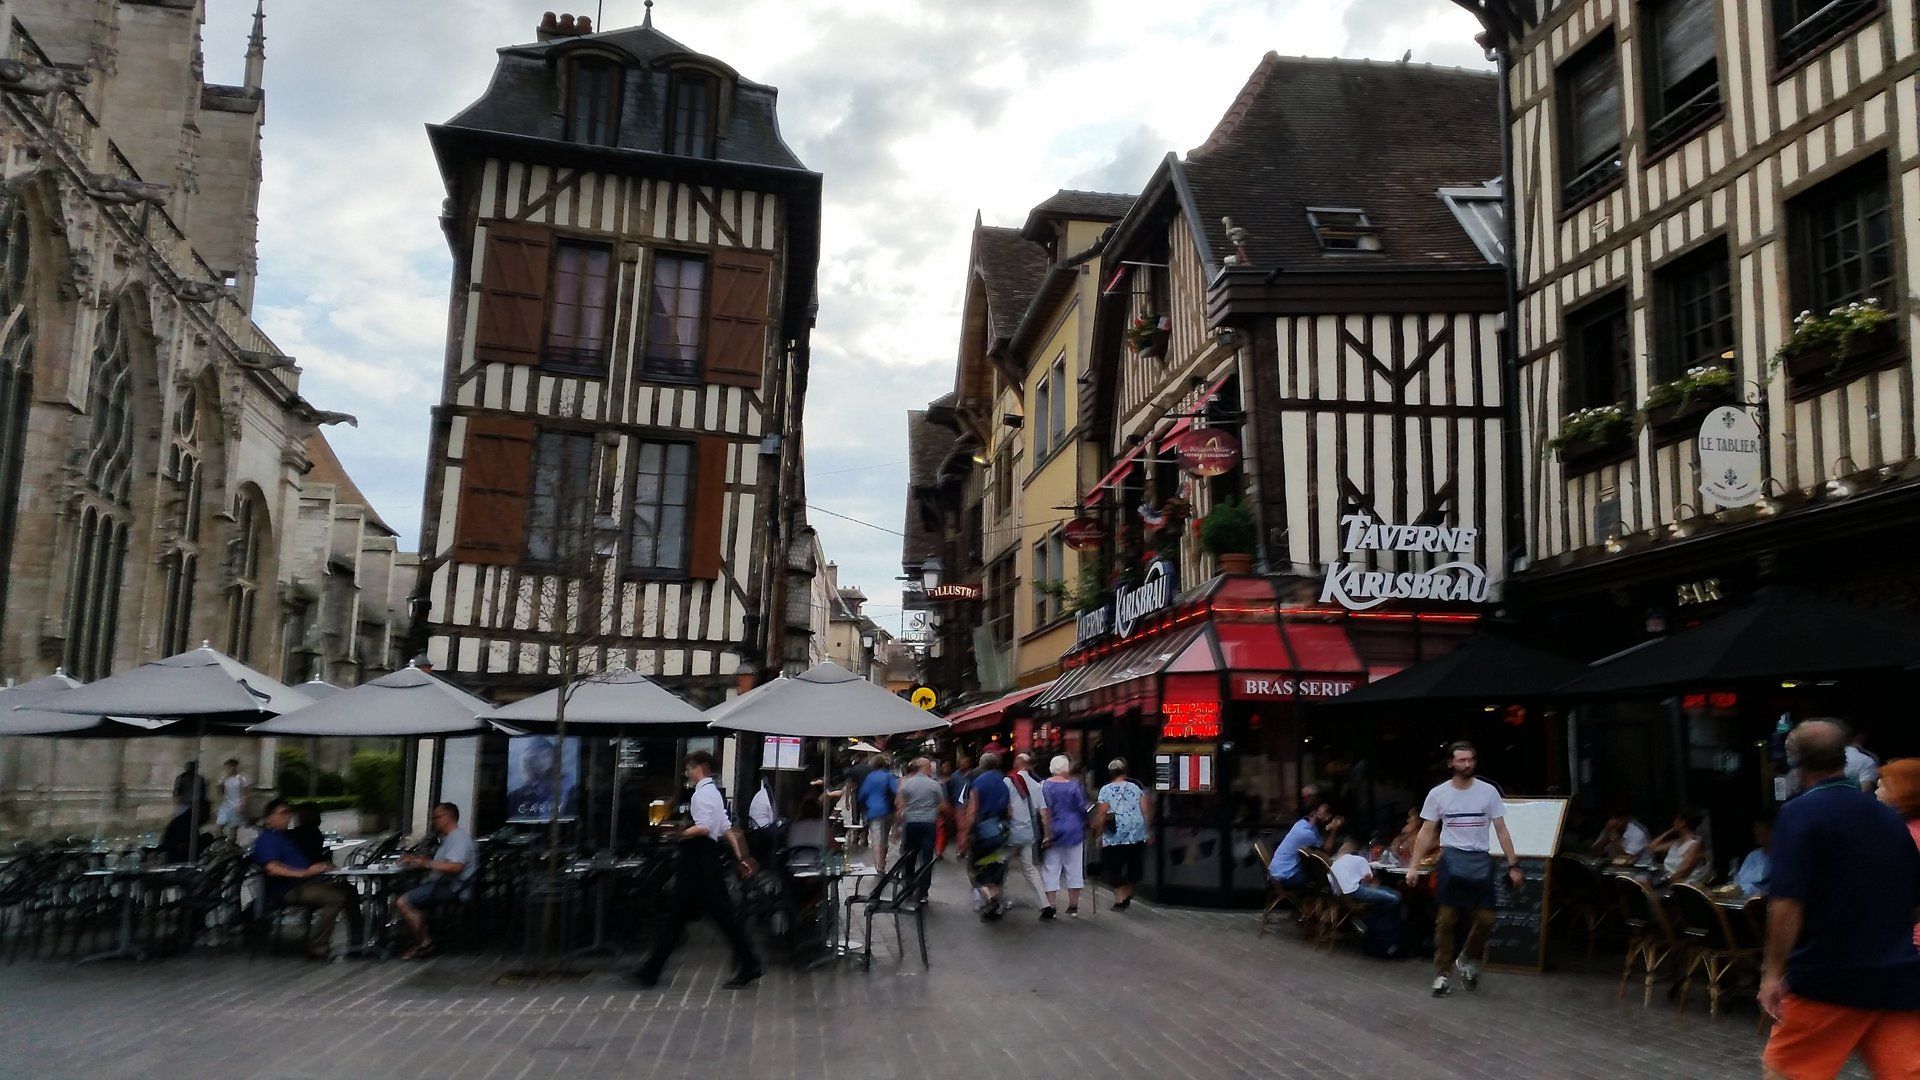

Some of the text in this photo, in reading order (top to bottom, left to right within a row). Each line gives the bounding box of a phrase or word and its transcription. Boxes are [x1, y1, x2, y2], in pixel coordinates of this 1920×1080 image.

[1700, 437, 1759, 454] LE TABLIER
[1340, 510, 1478, 552] TAVERNE
[1676, 578, 1722, 606] BAR
